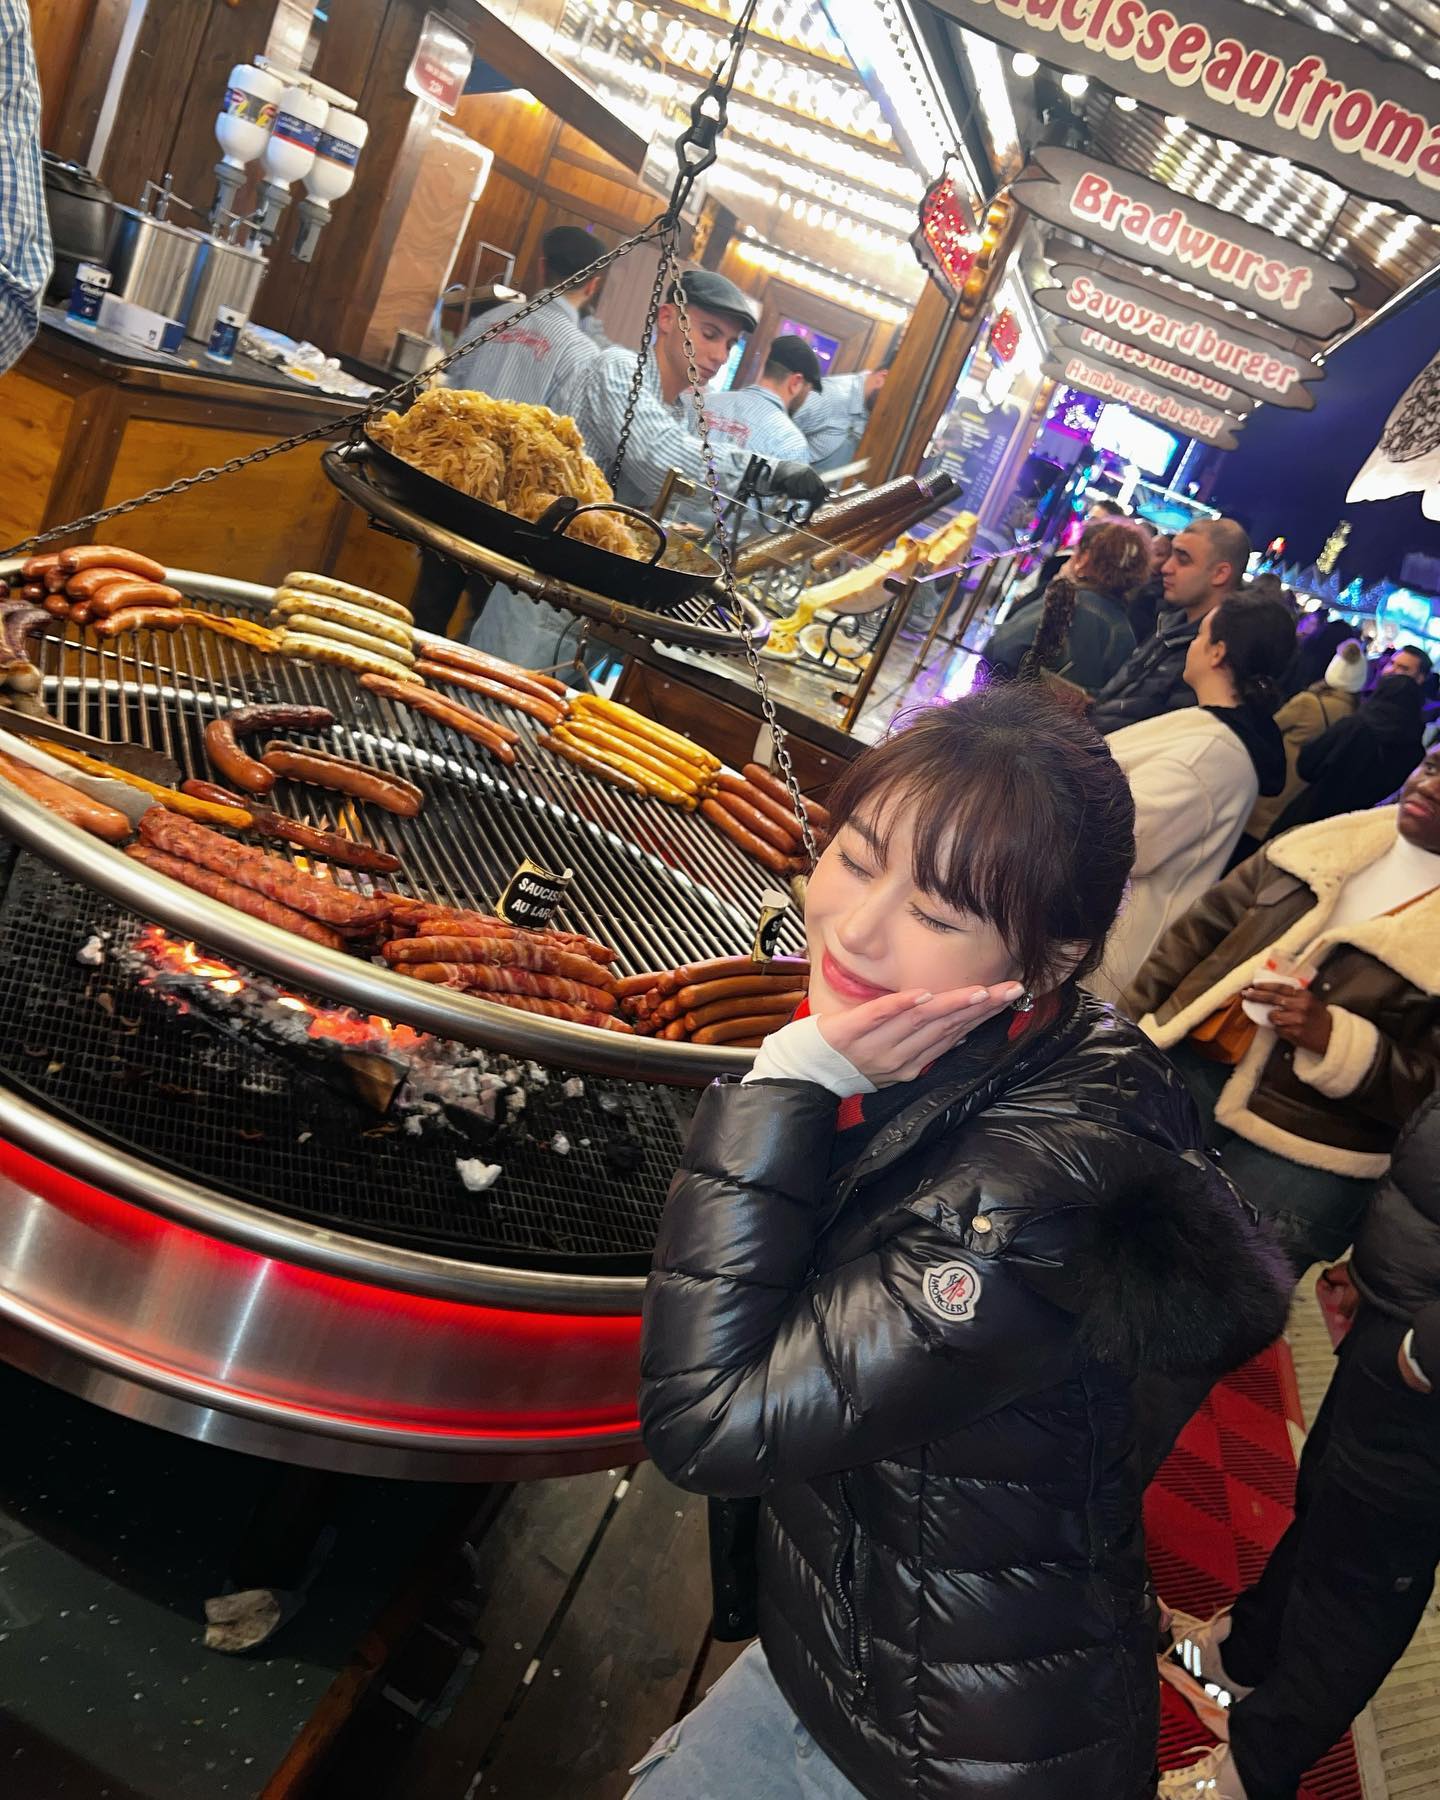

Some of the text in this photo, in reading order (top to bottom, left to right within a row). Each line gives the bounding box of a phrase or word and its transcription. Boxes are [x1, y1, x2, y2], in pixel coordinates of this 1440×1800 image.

[1202, 37, 1285, 117] au
[1070, 172, 1312, 310] Bradwurst
[1064, 358, 1158, 414] Hamburger
[511, 898, 531, 913] AU
[931, 1278, 963, 1312] MONCLER
